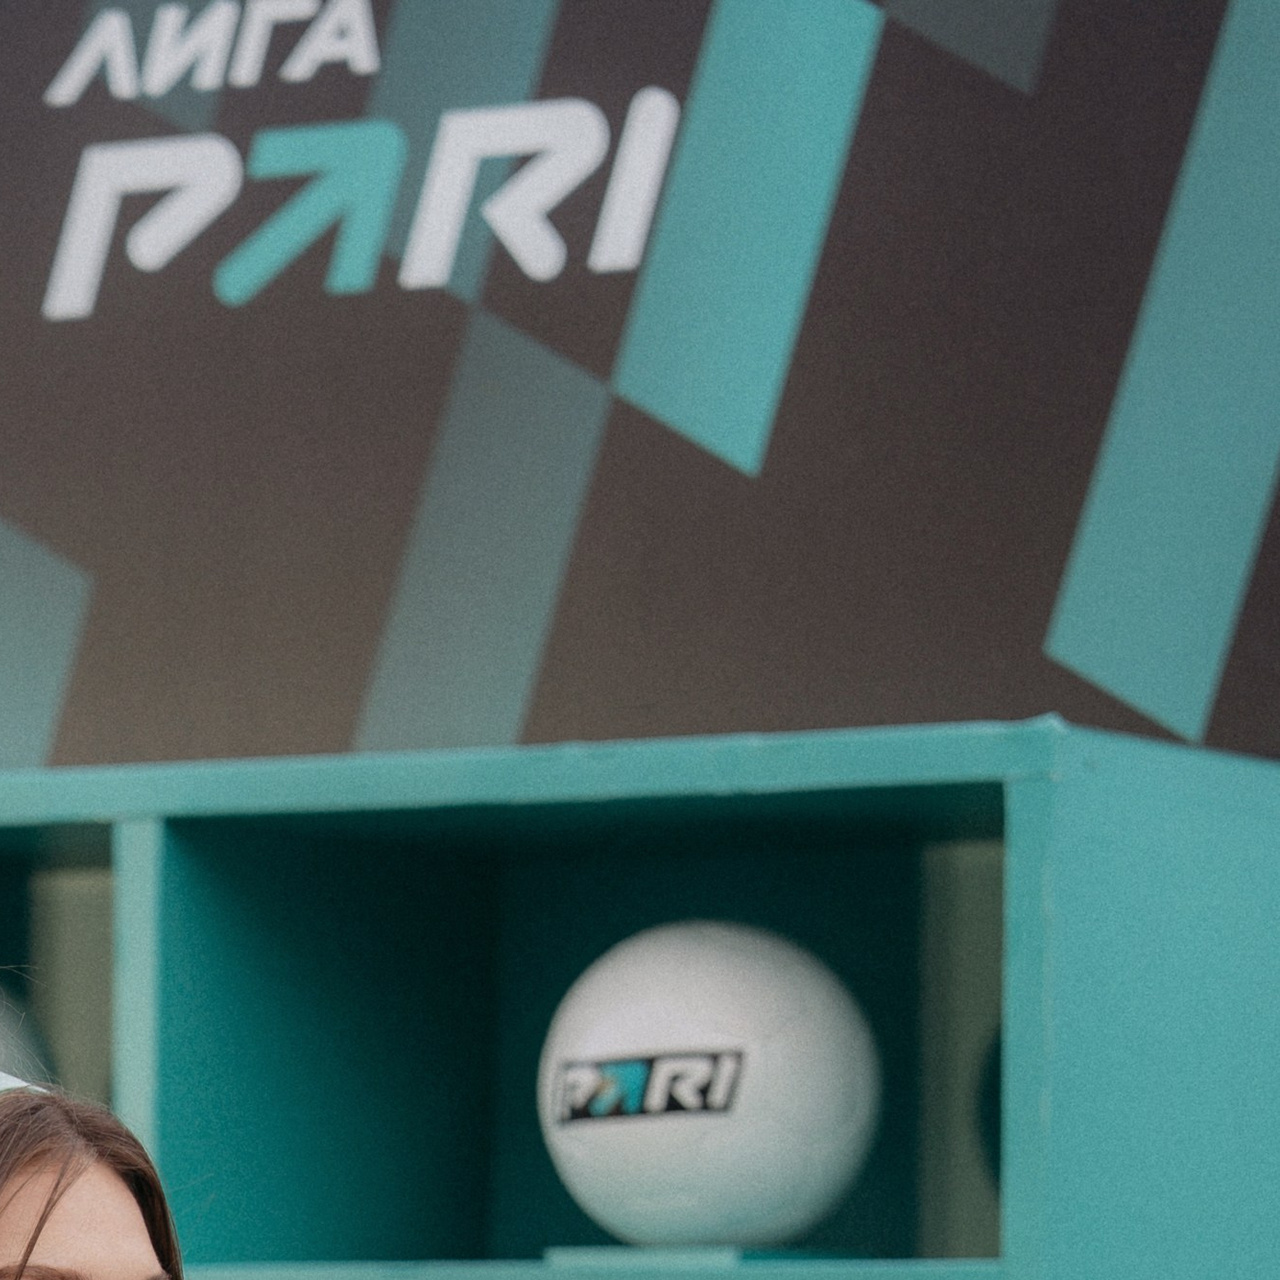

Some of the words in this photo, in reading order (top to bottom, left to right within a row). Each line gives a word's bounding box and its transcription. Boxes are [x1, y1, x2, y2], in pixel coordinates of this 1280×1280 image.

[42, 0, 382, 108] ЛИГА
[42, 85, 681, 321] PARI
[562, 1053, 739, 1121] PARI
